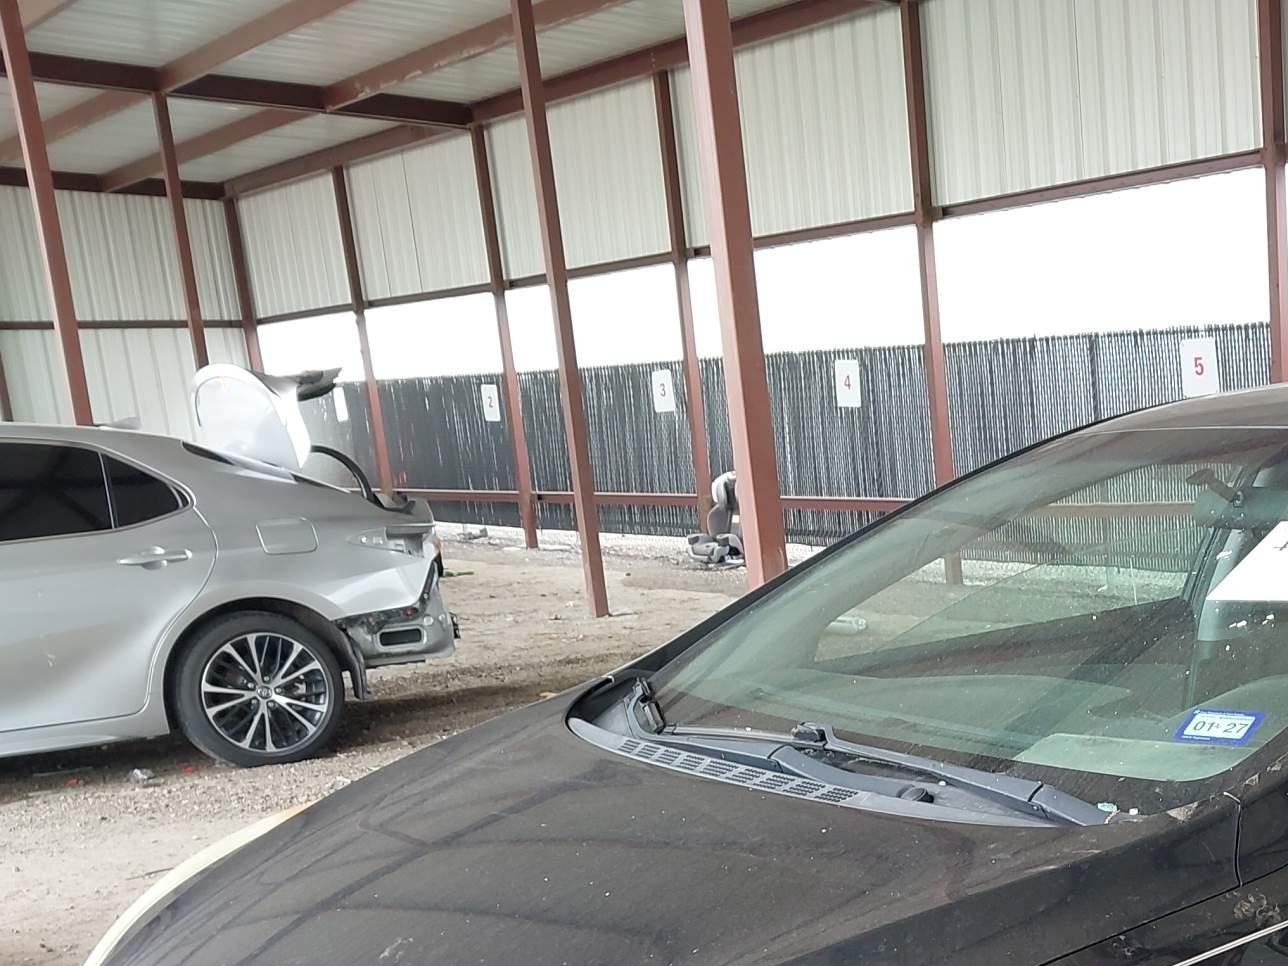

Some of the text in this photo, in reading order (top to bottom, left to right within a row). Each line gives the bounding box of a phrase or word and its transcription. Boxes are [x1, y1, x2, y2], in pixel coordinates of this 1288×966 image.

[1193, 356, 1205, 376] 5
[660, 383, 667, 398] 3
[843, 375, 852, 391] 4
[488, 395, 494, 409] 2
